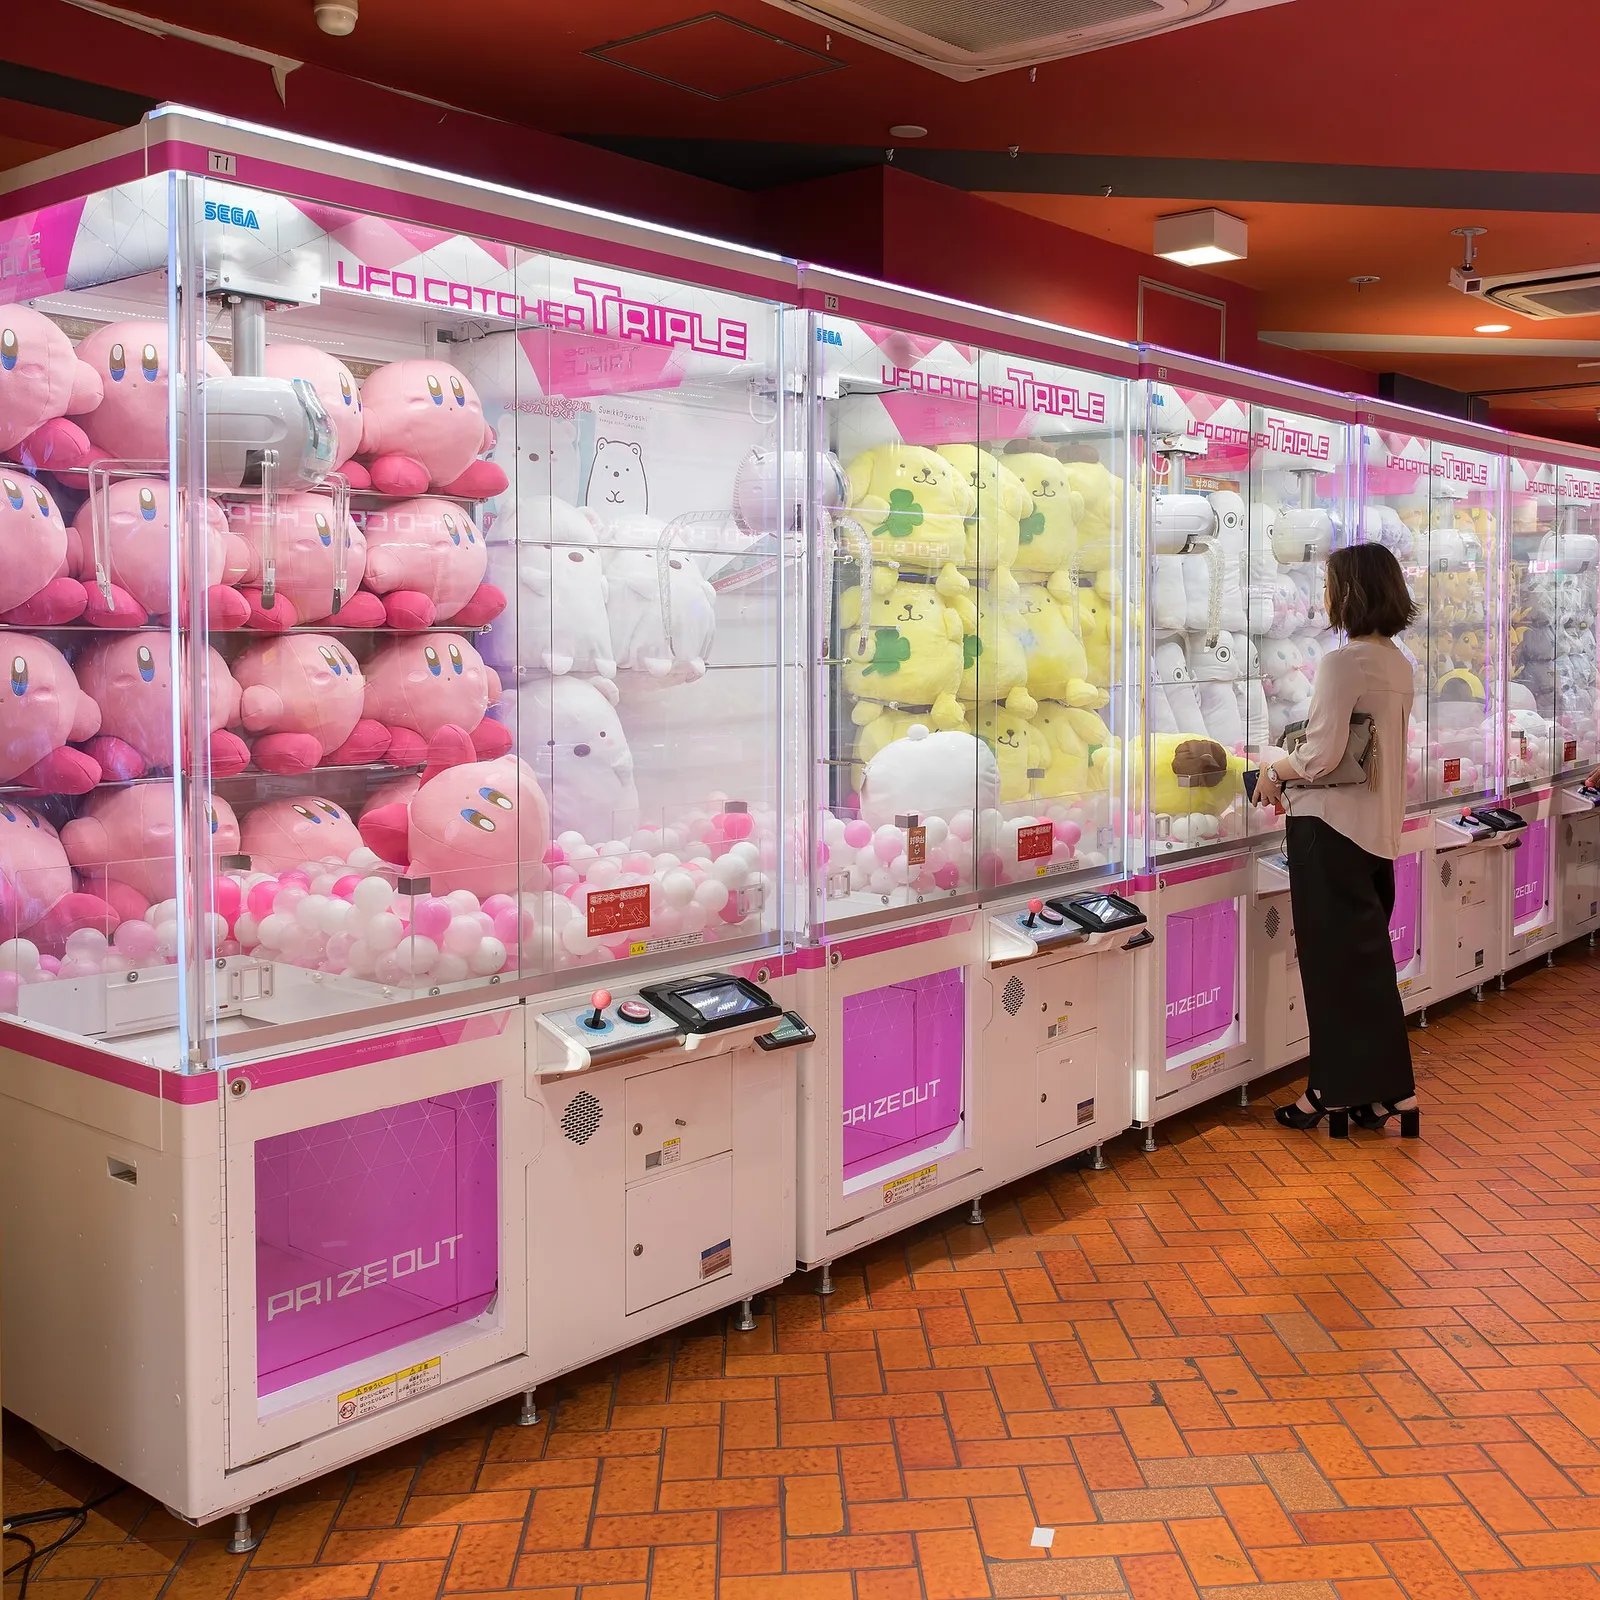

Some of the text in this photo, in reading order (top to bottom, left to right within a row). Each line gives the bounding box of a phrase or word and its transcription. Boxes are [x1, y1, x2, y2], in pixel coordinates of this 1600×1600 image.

[214, 155, 229, 171] T1
[205, 201, 260, 229] SEGA
[338, 260, 748, 361] UFO CATCHER TRIPLE
[827, 297, 837, 308] T2
[816, 327, 843, 347] SEGA
[881, 365, 1105, 424] UFO CATCHER TRIPLE
[1186, 417, 1330, 461] UFO CATCHER TRIPLE
[1386, 451, 1488, 485] UFO CATCHER TRIPLE
[1166, 986, 1221, 1019] RIZEOUT
